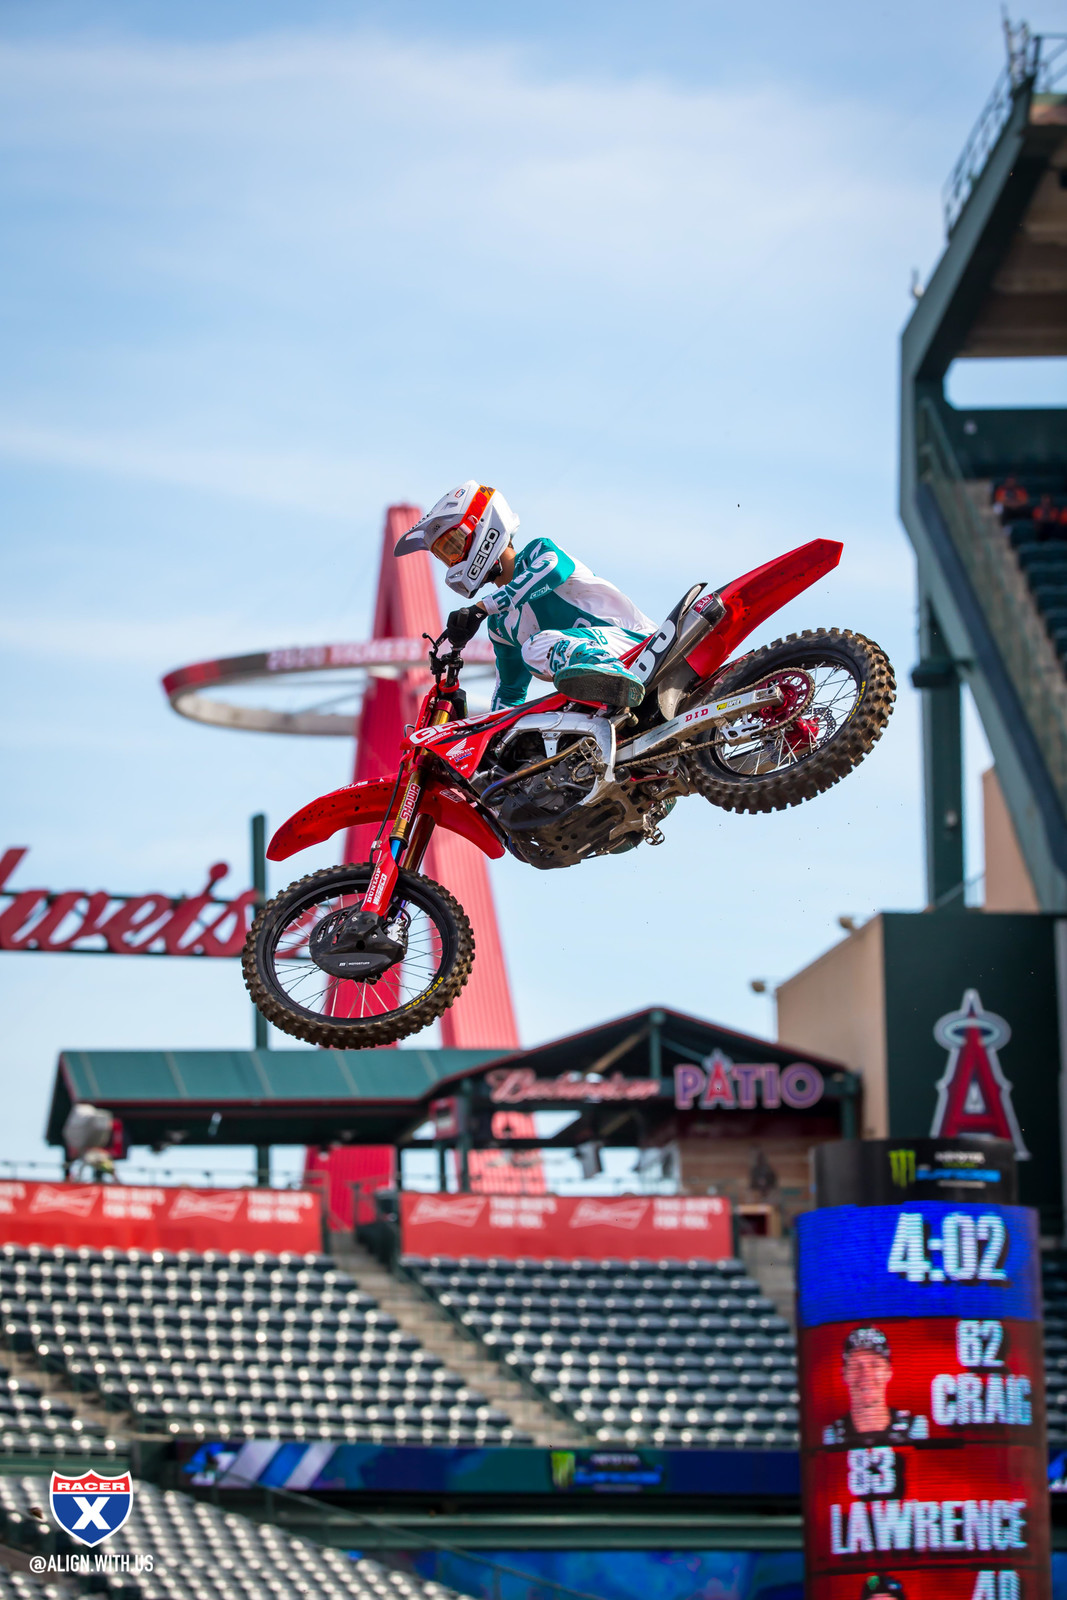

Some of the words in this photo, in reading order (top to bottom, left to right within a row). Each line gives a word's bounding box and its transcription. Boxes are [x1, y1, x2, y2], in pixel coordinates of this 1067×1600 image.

[467, 528, 499, 580] GEICO
[685, 708, 709, 722] DID
[400, 783, 421, 823] SHOWA
[366, 867, 381, 903] DUNLOP
[405, 976, 444, 1010] DUNLOP
[673, 1052, 825, 1111] PATIO
[888, 1212, 1006, 1281] 4:02
[957, 1320, 1004, 1367] 62
[931, 1373, 1032, 1425] CRAIG
[848, 1446, 896, 1496] 83
[830, 1499, 1027, 1554] LAWRENCE
